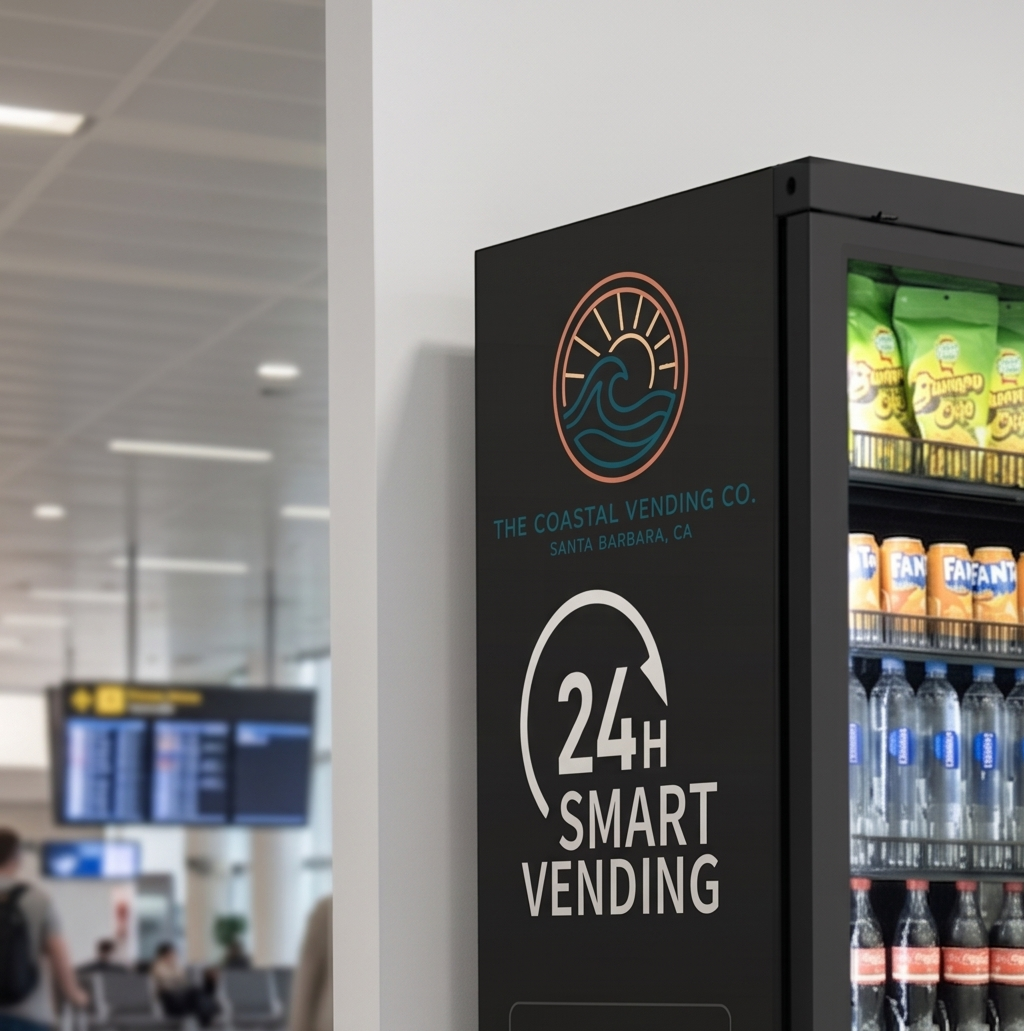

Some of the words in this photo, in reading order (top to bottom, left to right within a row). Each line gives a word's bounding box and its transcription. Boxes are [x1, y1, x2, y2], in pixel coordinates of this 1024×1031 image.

[493, 516, 528, 540] THE
[534, 503, 619, 534] COASTAL
[625, 488, 714, 521] VENDING
[721, 483, 756, 507] CO.
[550, 537, 594, 557] SANTA
[598, 527, 669, 551] BARBARA,
[673, 523, 693, 541] CA
[558, 781, 718, 851] SMART
[521, 853, 720, 917] VENDING
